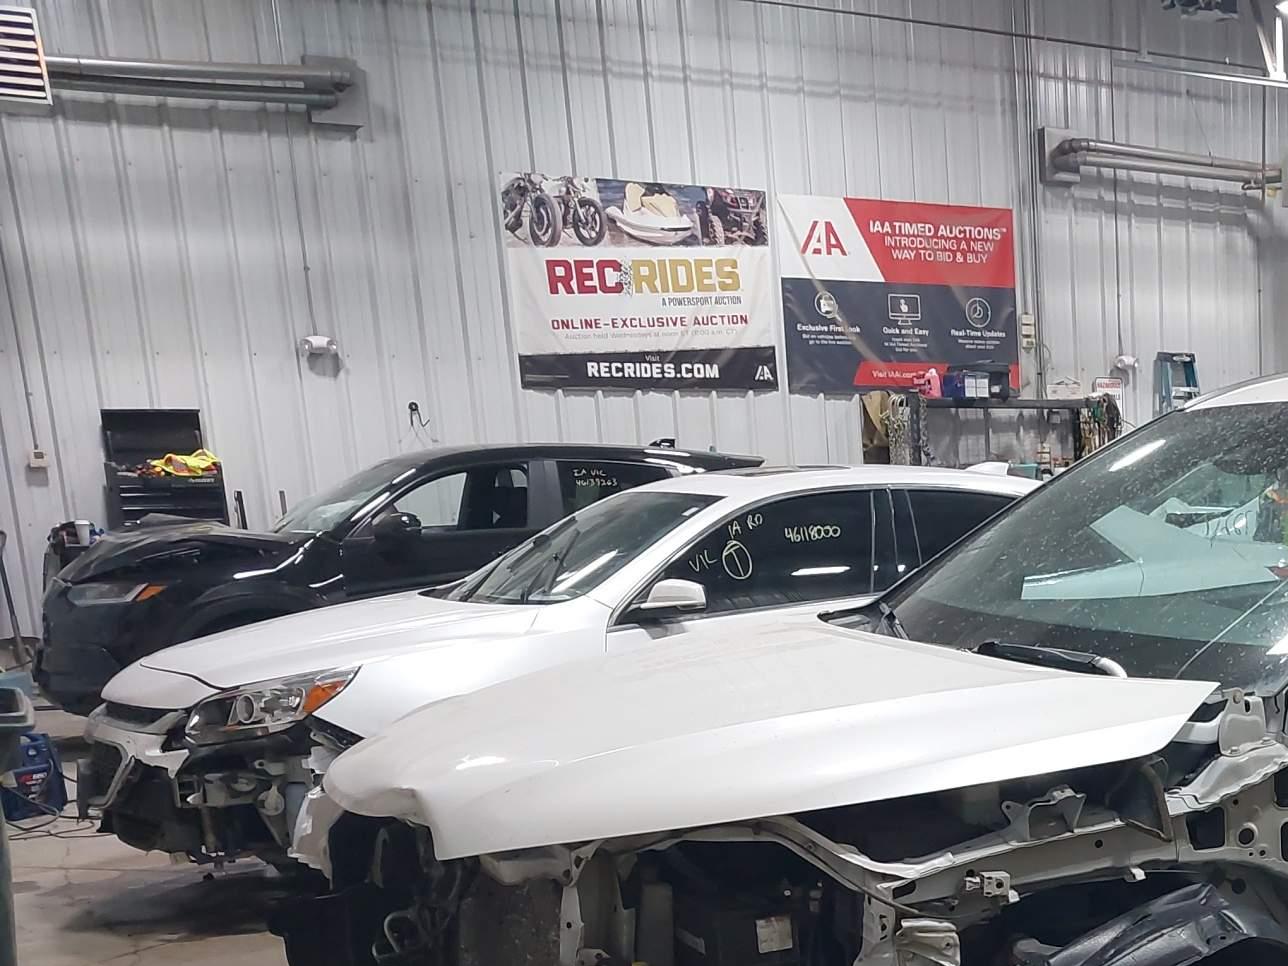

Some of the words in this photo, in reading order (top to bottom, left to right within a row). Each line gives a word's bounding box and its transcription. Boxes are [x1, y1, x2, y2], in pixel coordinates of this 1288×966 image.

[869, 219, 892, 234] IAA
[894, 221, 935, 237] TIMED
[884, 235, 958, 251] INTRODUCING
[959, 240, 968, 250] A
[970, 241, 994, 252] NEW
[891, 249, 916, 260] WAY
[920, 250, 934, 261] TO
[937, 251, 953, 262] BID
[955, 252, 964, 263] &
[966, 253, 988, 264] BUY
[545, 259, 625, 295] REC
[632, 258, 741, 293] RIDES
[661, 297, 666, 306] A
[667, 296, 713, 306] POWERSPORT
[714, 295, 742, 305] AUCTION
[551, 316, 687, 330] ONLINE-EXCLUSIVE
[693, 314, 749, 328] AUCTION
[797, 323, 828, 332] Exclusive
[829, 324, 846, 332] Firs
[882, 326, 900, 335] Quick
[901, 327, 914, 335] and
[914, 328, 929, 337] Easy
[950, 329, 981, 337] Real-Time
[982, 330, 1006, 338] Updates
[645, 354, 660, 362] Visit
[586, 362, 720, 379] RECRIDES.COM
[872, 370, 887, 378] Visit
[784, 525, 841, 543] 46118000
